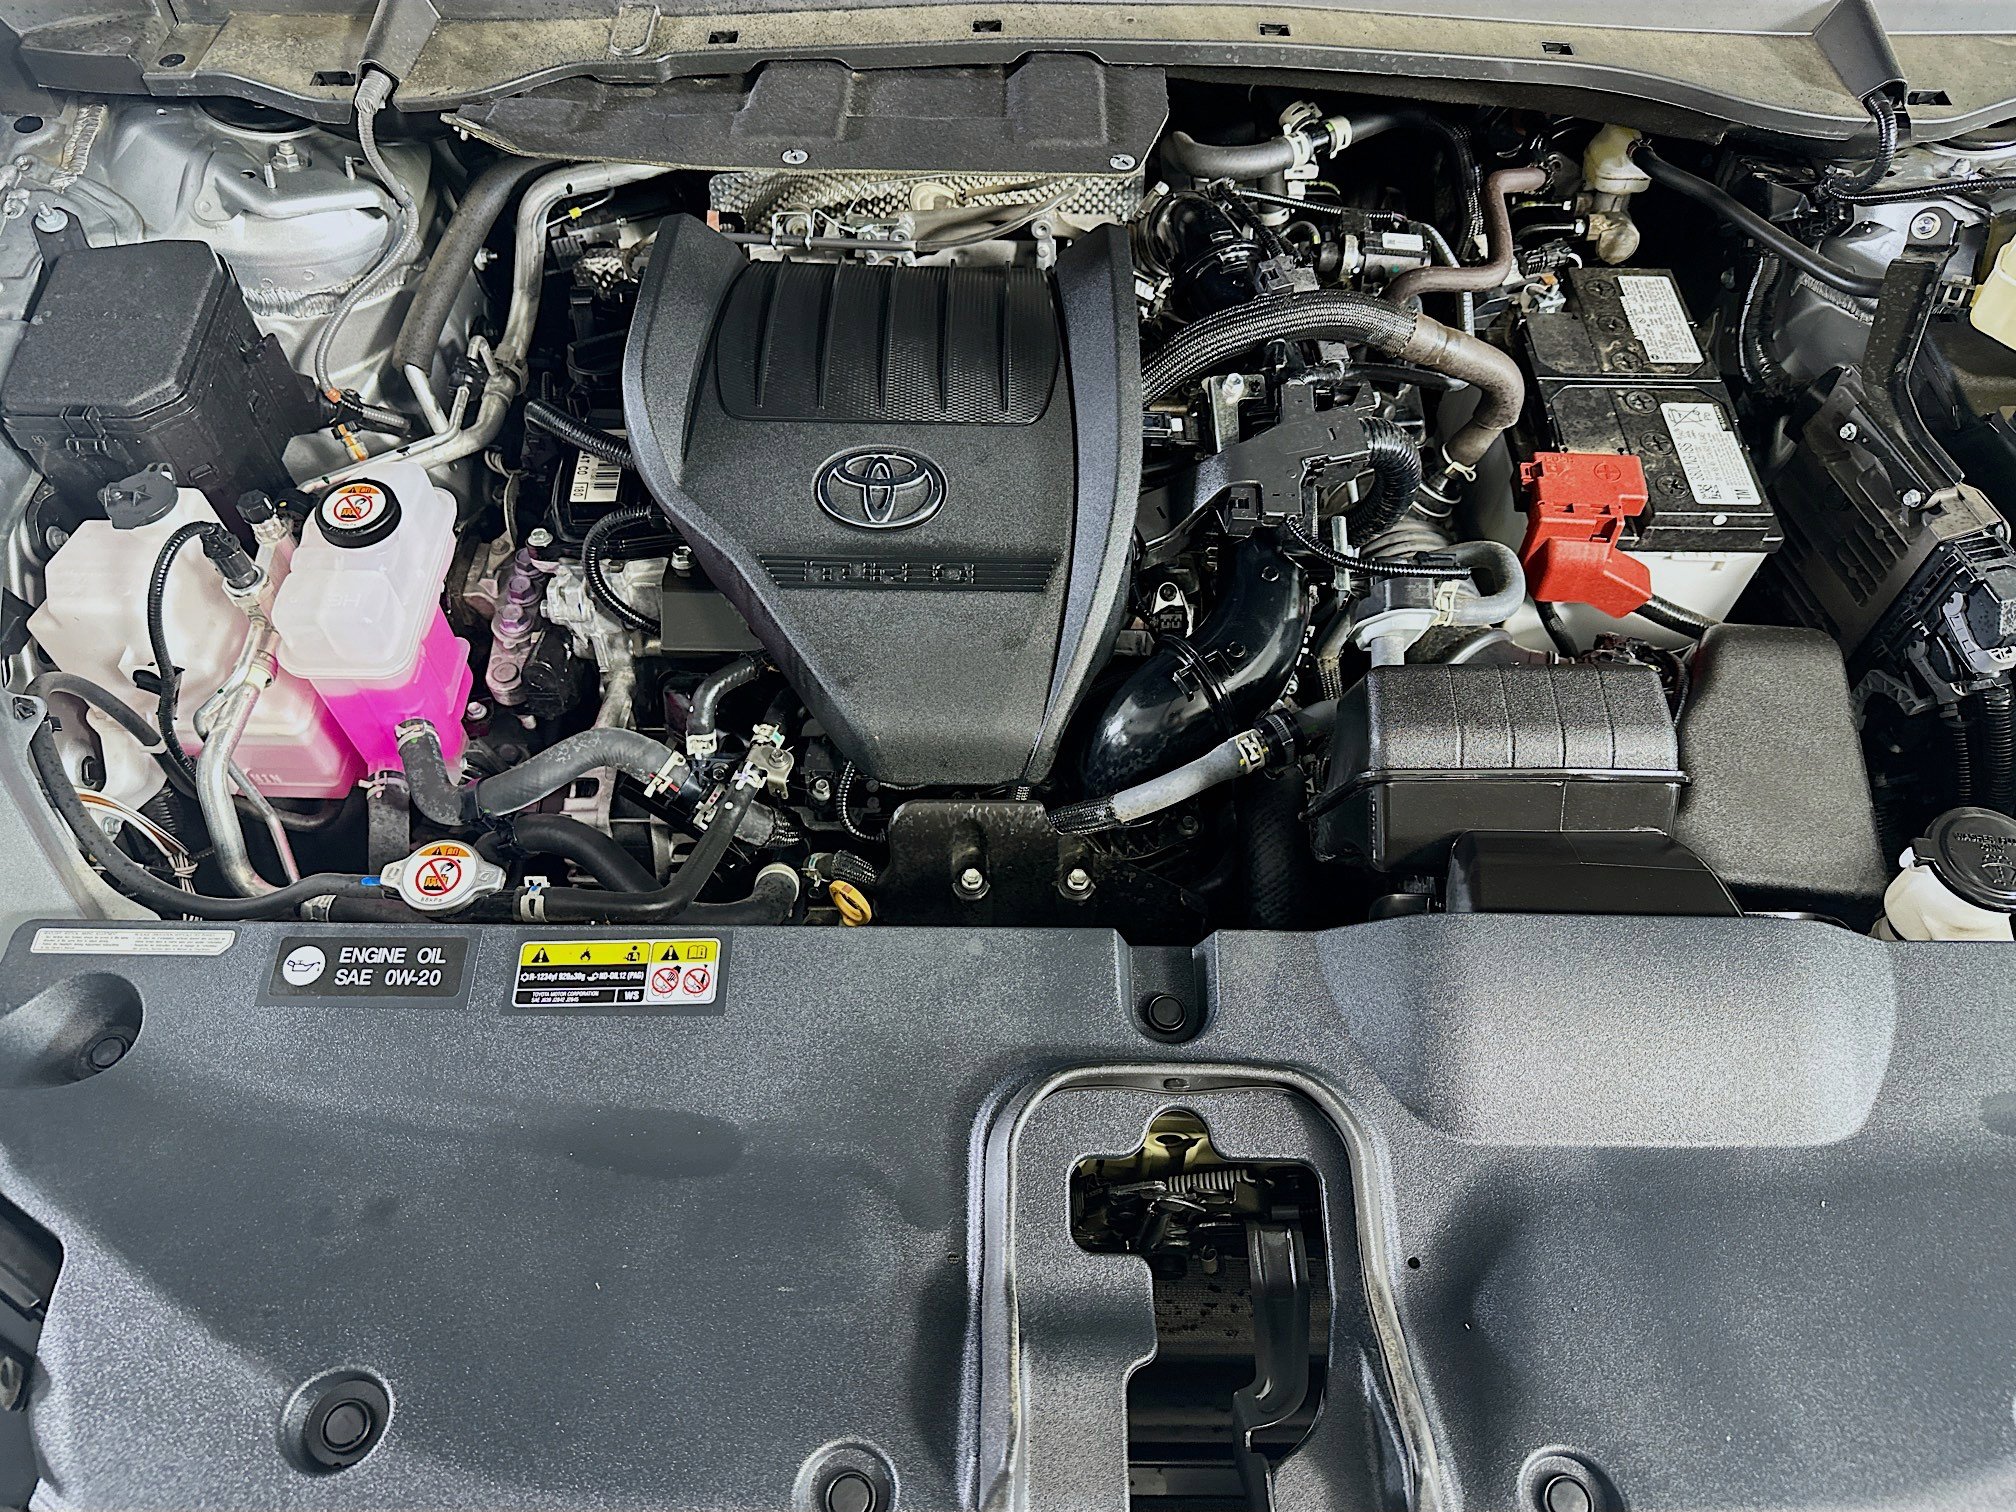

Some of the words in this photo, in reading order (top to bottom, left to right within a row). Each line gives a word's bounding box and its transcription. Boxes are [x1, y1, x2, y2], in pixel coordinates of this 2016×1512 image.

[803, 560, 975, 584] TURBO
[1953, 832, 1995, 844] WASHER
[339, 947, 407, 964] ENGINE
[417, 947, 446, 964] OIL
[334, 968, 373, 986] SAE
[384, 969, 442, 986] 0W-20
[624, 991, 640, 1001] WS
